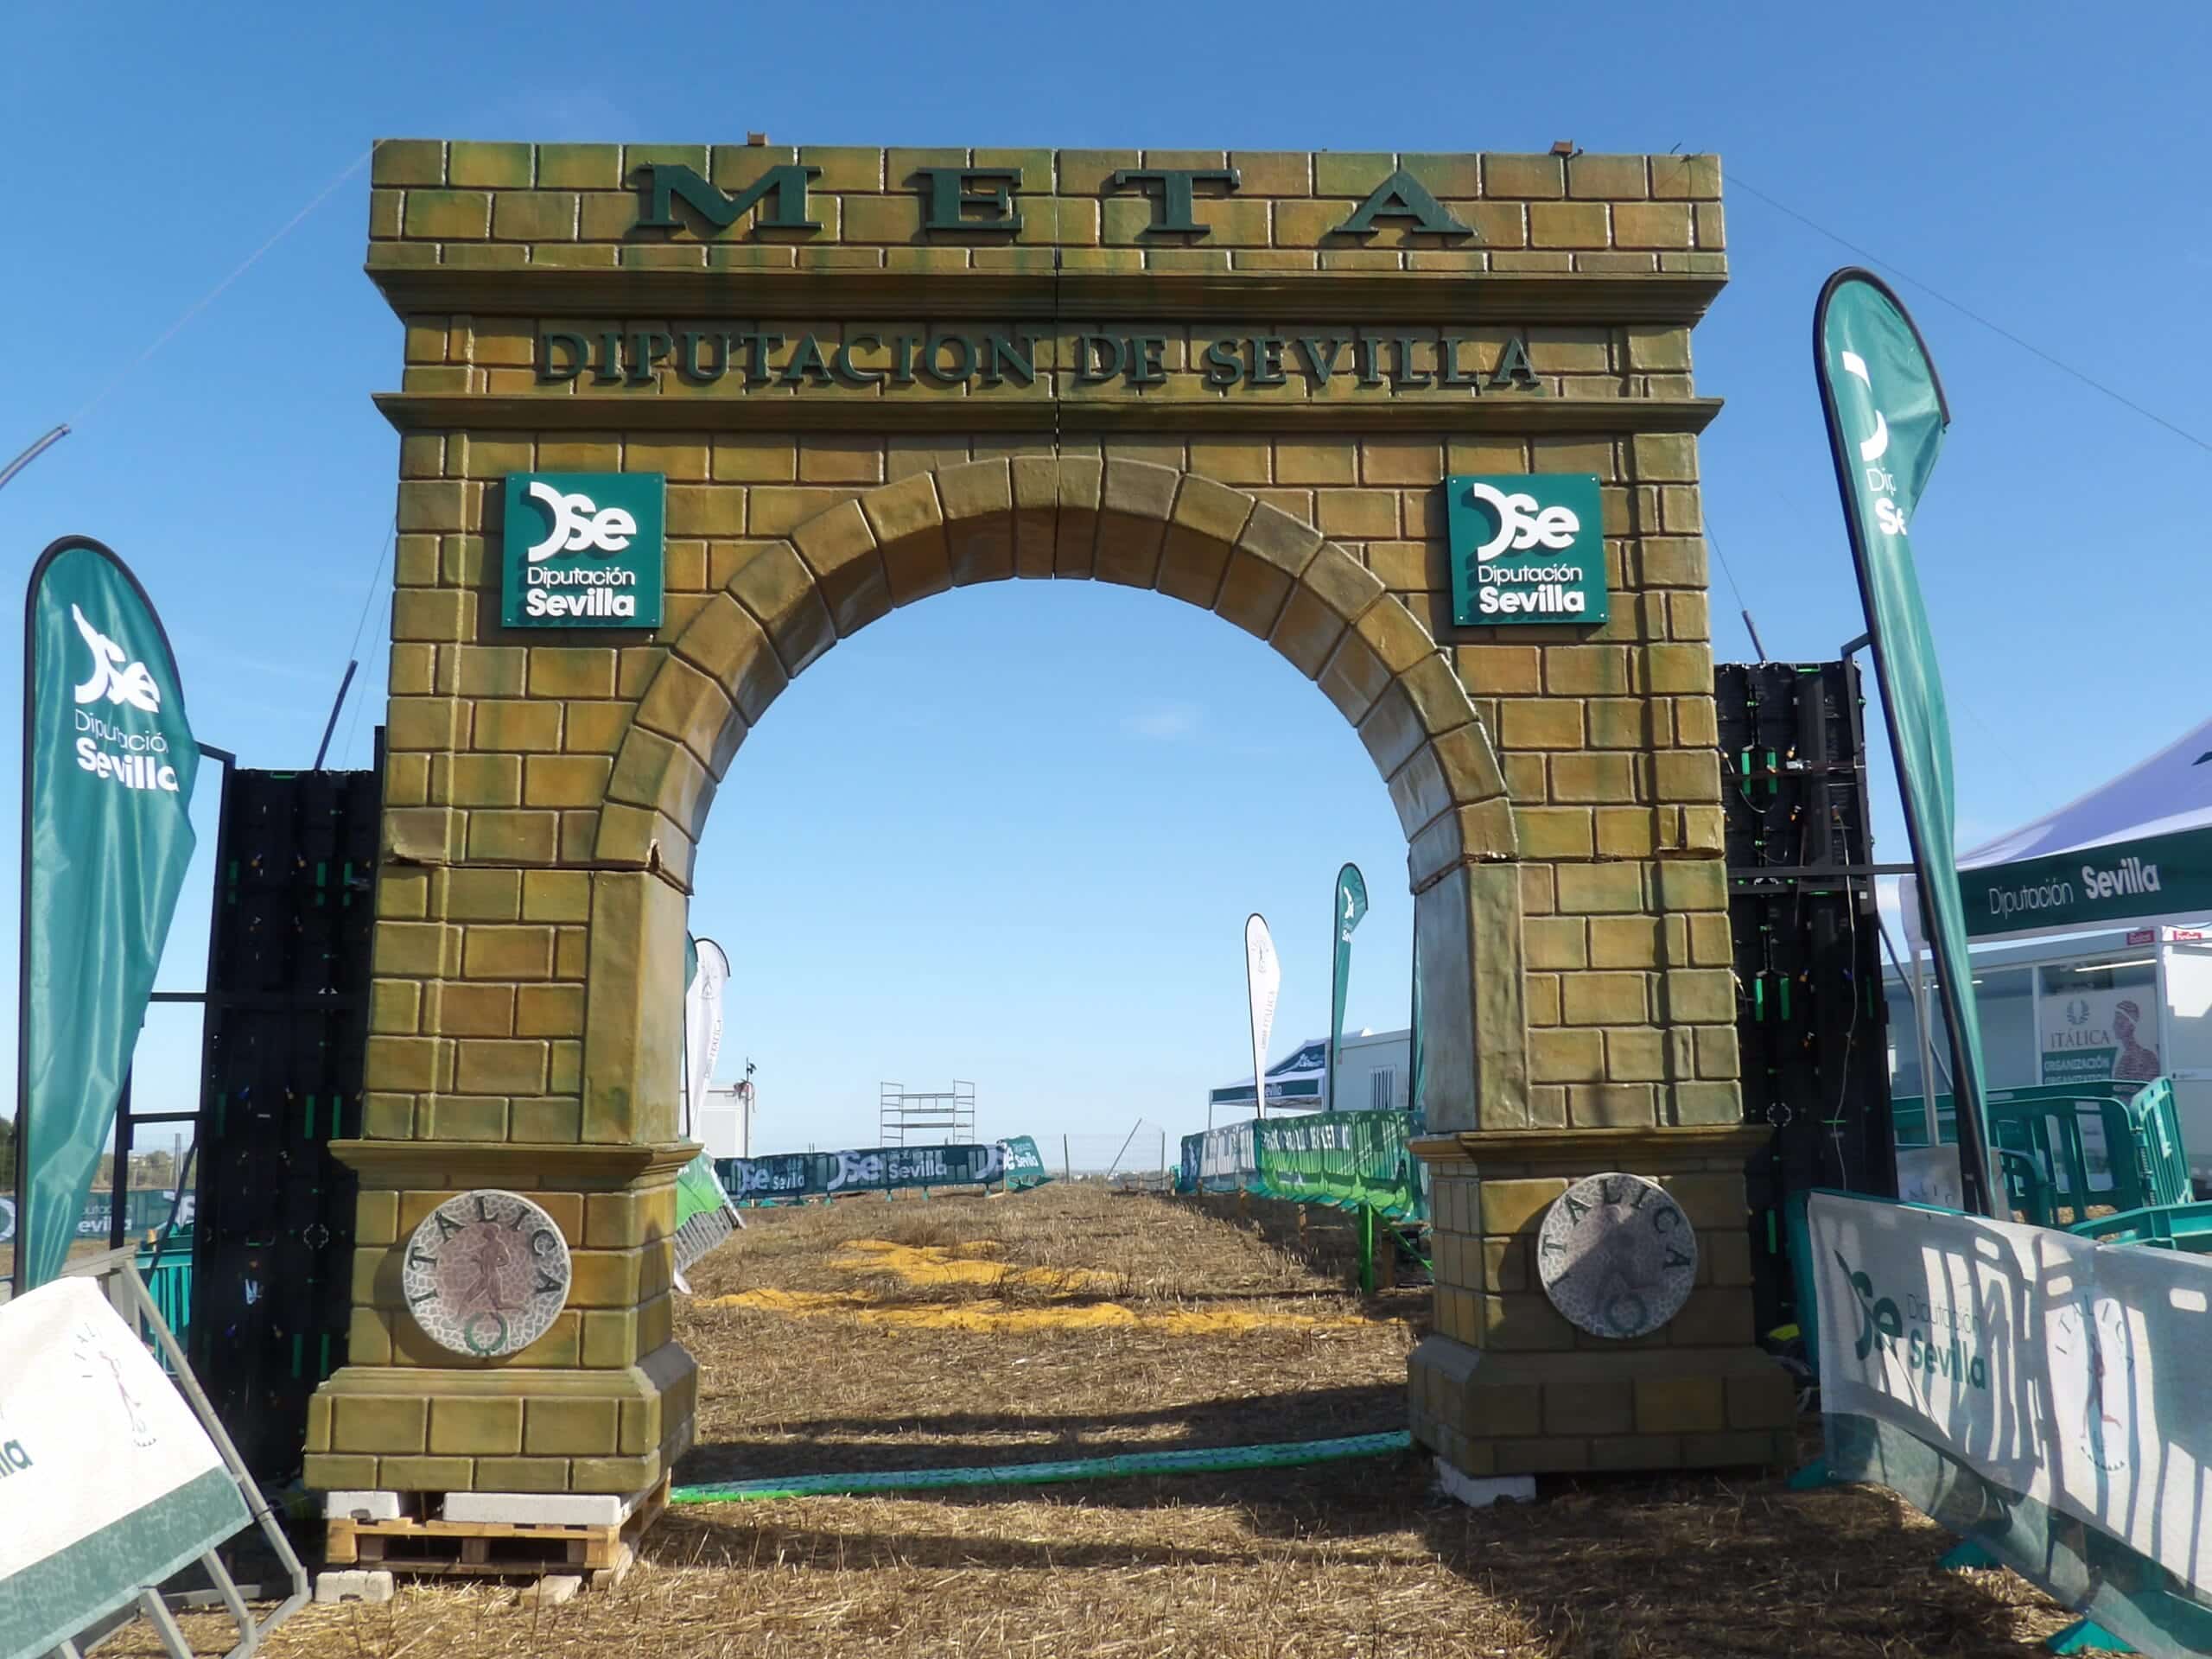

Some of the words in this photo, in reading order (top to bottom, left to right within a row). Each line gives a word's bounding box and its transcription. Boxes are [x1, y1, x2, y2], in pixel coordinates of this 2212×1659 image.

[632, 163, 1478, 237] META
[539, 331, 1038, 385] DIPUTACION
[1078, 333, 1168, 385] DE
[1208, 334, 1541, 388] SEVILLA
[526, 565, 636, 587] Diputación
[1478, 563, 1583, 583] Diputación
[525, 588, 636, 618] Sevilla
[1478, 585, 1586, 614] Sevilla
[1988, 878, 2074, 920] Diputación
[2081, 856, 2161, 900] Sevilla
[888, 1160, 948, 1180] Sevilla
[1910, 1329, 1986, 1390] Sevilla
